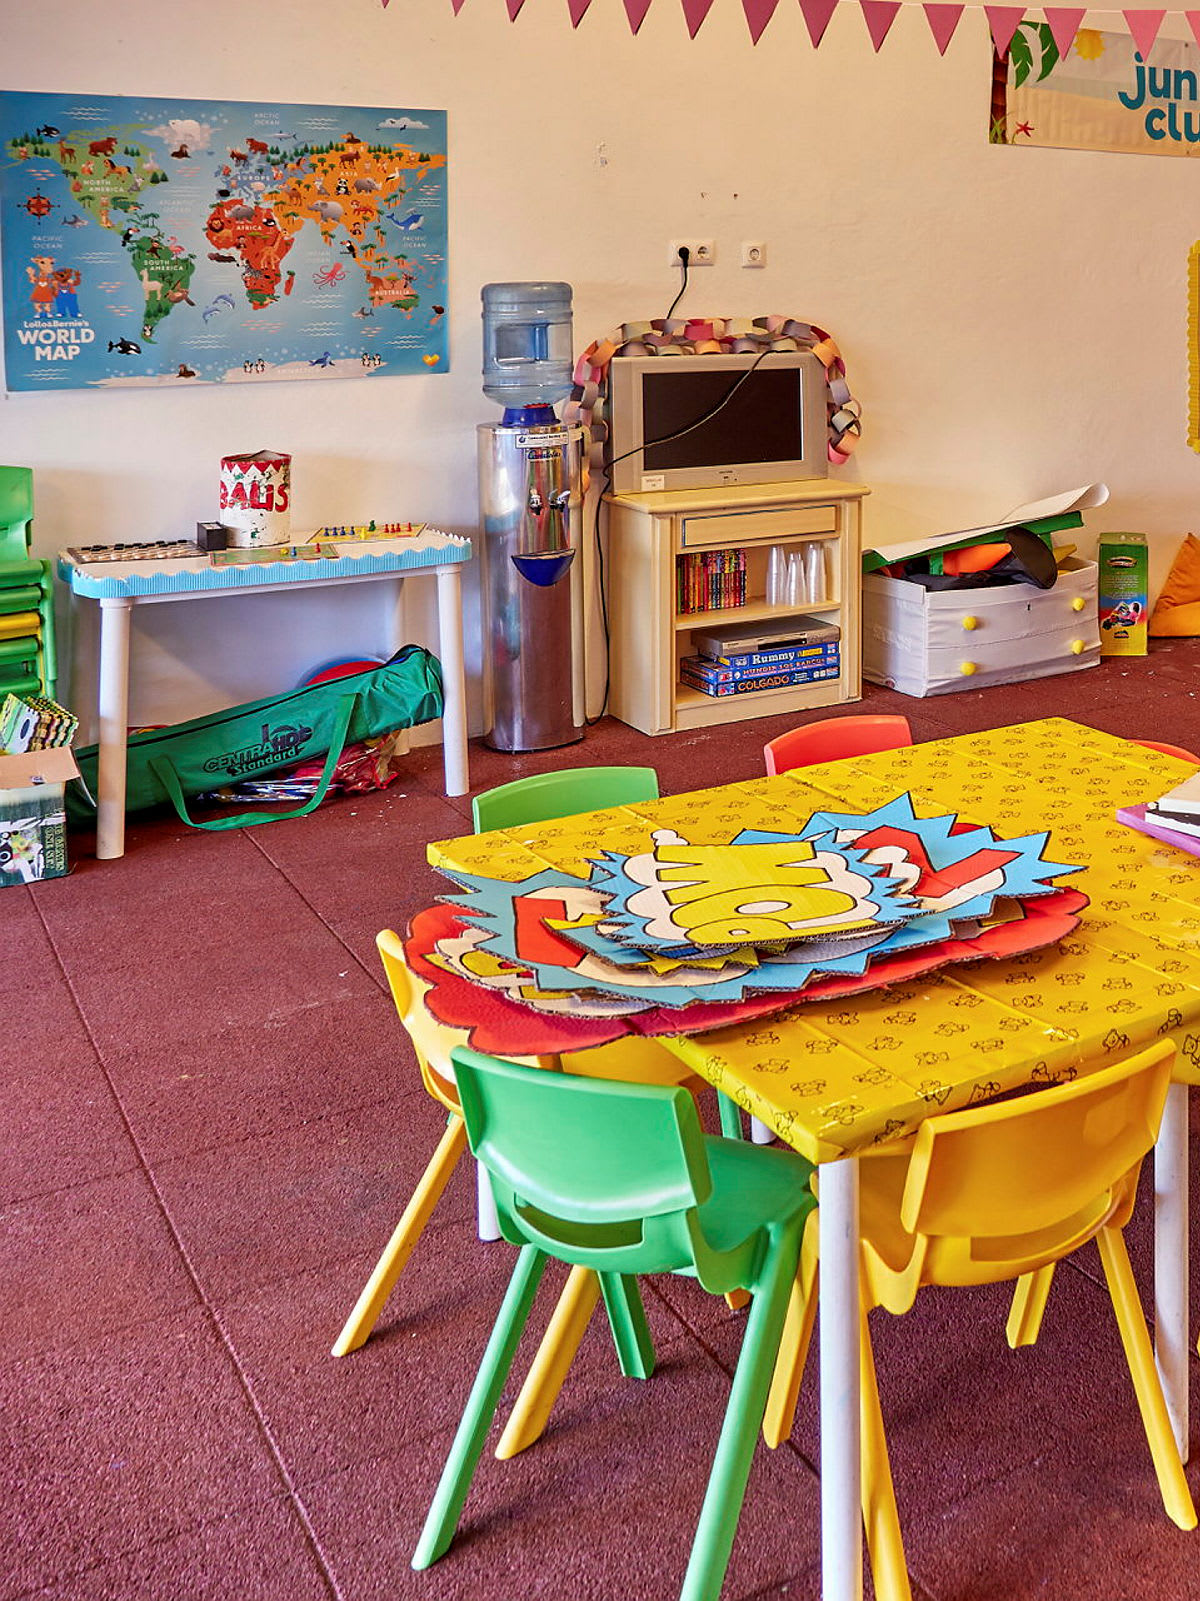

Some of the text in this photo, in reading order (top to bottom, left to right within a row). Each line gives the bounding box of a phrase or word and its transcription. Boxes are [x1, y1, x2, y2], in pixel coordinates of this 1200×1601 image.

[17, 328, 96, 345] WORLD
[35, 345, 81, 361] MAP
[752, 651, 795, 665] Rummy
[737, 675, 790, 691] COLGADO
[232, 745, 298, 776] Standard
